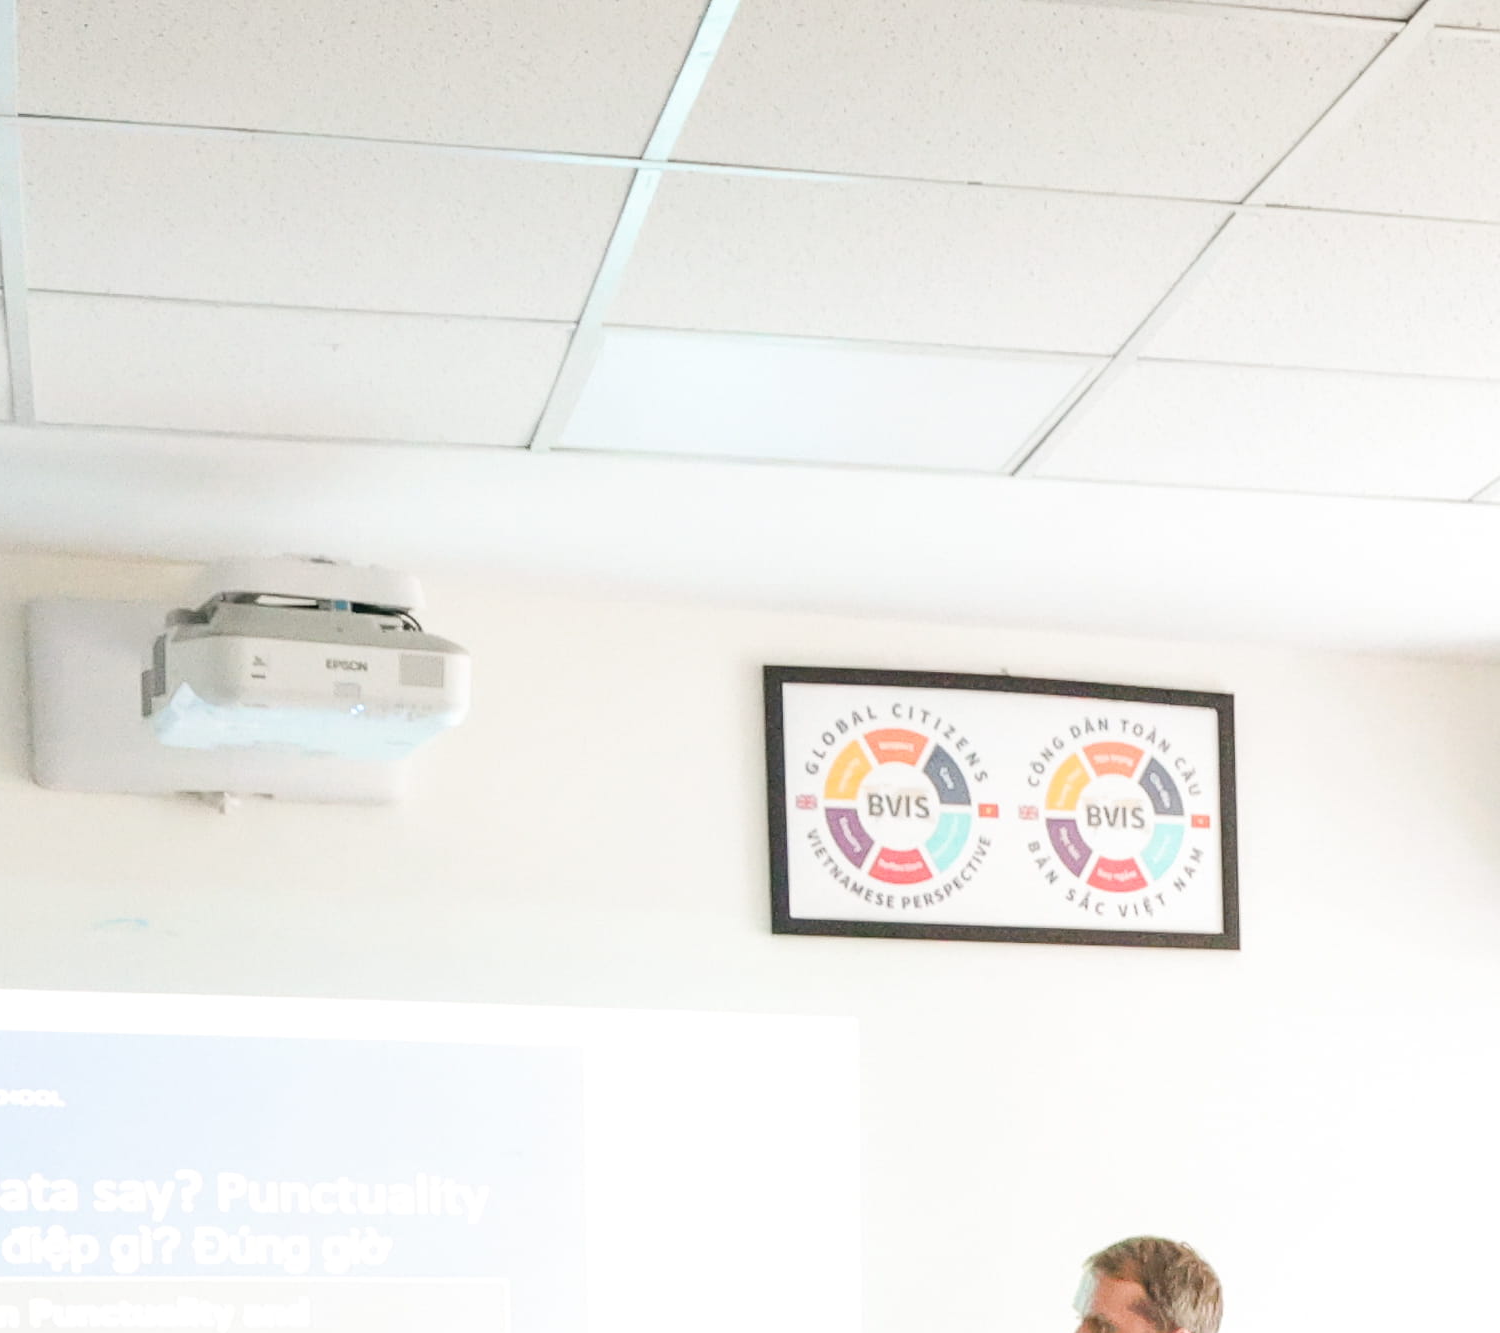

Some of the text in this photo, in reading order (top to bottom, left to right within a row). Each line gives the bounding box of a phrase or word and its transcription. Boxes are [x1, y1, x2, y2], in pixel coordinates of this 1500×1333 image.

[326, 658, 368, 672] EPSON
[805, 705, 877, 775] GLOBAL
[892, 703, 989, 783] CITIZENS
[867, 793, 930, 819] BVIS
[1086, 804, 1145, 829] BVIS
[806, 828, 895, 909] VIETNAMESE
[901, 835, 991, 909] PERSPECTIVE
[1173, 848, 1204, 892] NAM
[93, 1169, 203, 1221] say?
[217, 1170, 491, 1224] Punctuality
[1, 1225, 100, 1273] điệp
[191, 1225, 311, 1274] Đúng
